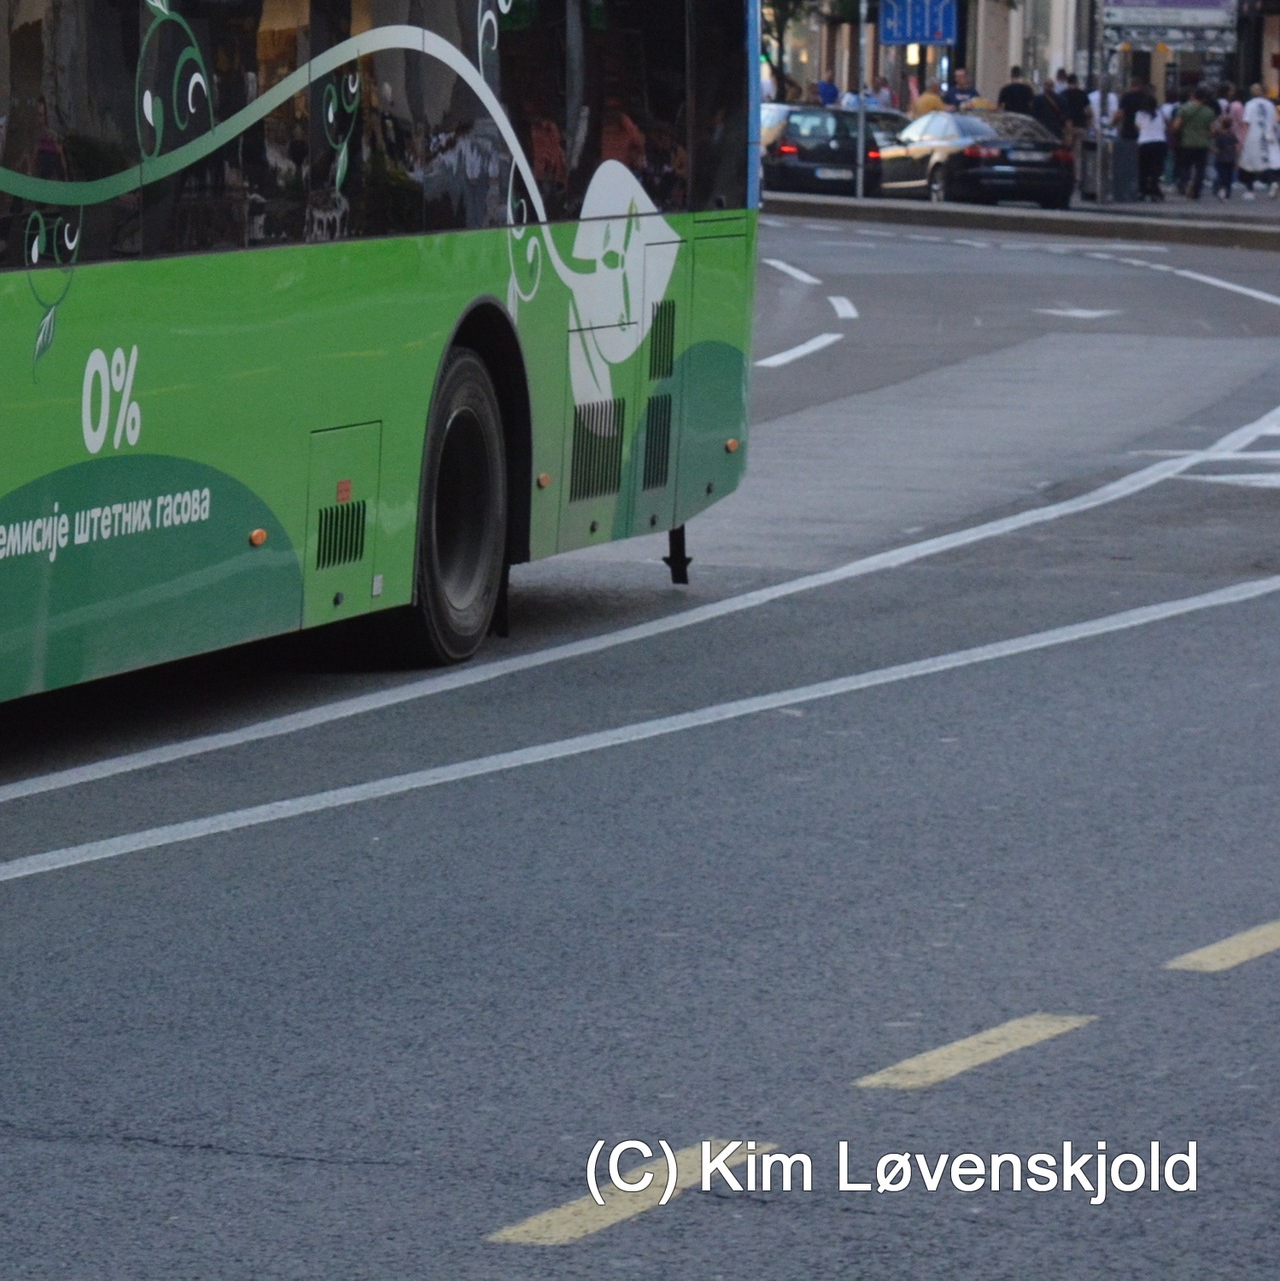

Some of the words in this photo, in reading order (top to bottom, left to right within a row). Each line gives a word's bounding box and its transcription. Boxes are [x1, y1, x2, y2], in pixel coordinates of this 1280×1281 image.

[81, 344, 141, 454] 0%
[73, 497, 152, 545] штетних
[155, 488, 211, 529] гасова
